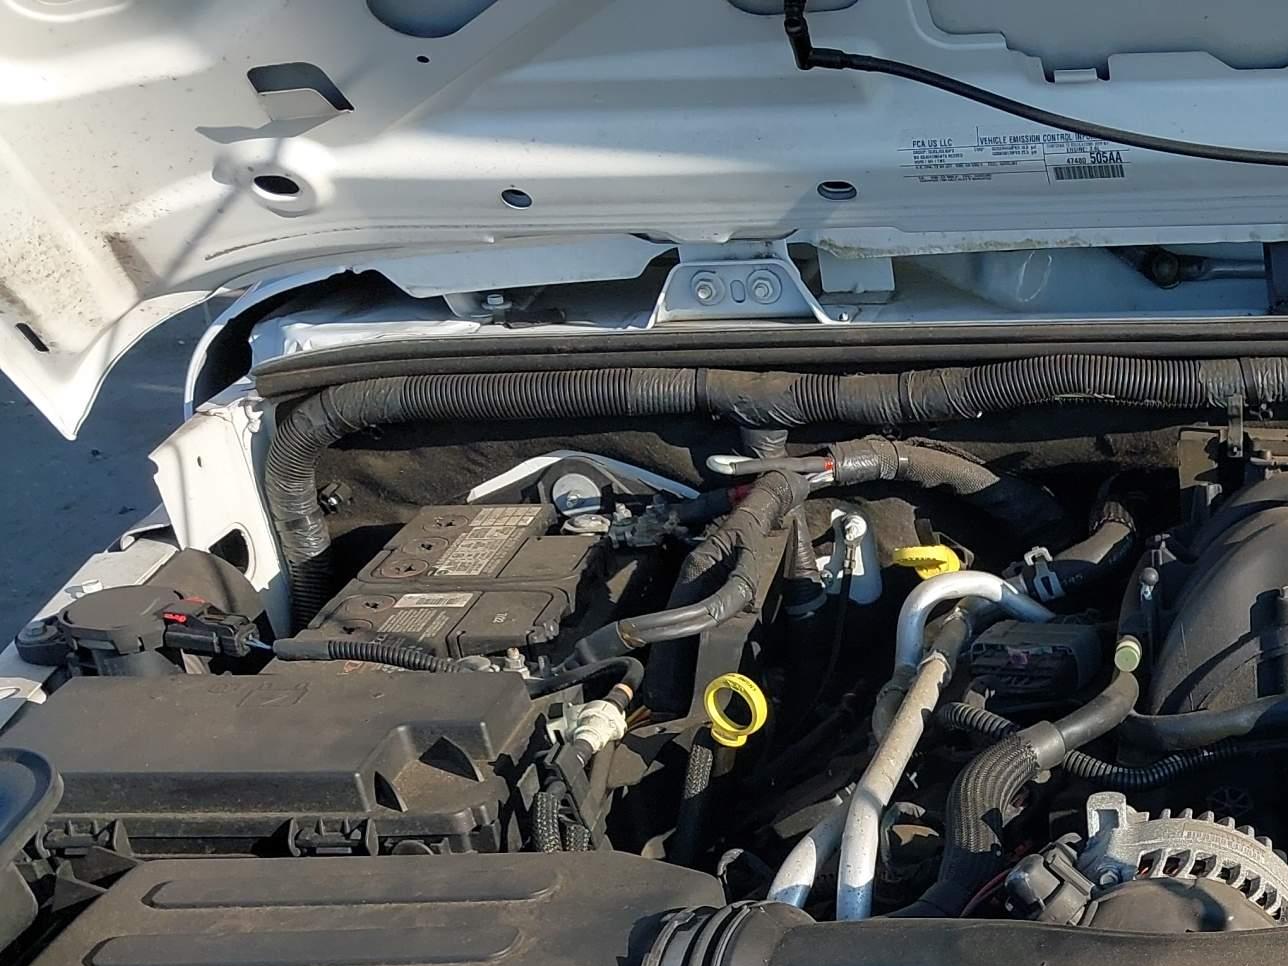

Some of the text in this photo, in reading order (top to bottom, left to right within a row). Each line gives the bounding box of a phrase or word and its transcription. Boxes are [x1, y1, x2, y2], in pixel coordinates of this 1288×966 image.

[912, 139, 953, 148] FCA US LLC
[980, 136, 1006, 145] VEHICLE
[1009, 134, 1040, 144] EMISSION
[1043, 133, 1073, 142] CONTROL
[1089, 151, 1123, 164] 505AA
